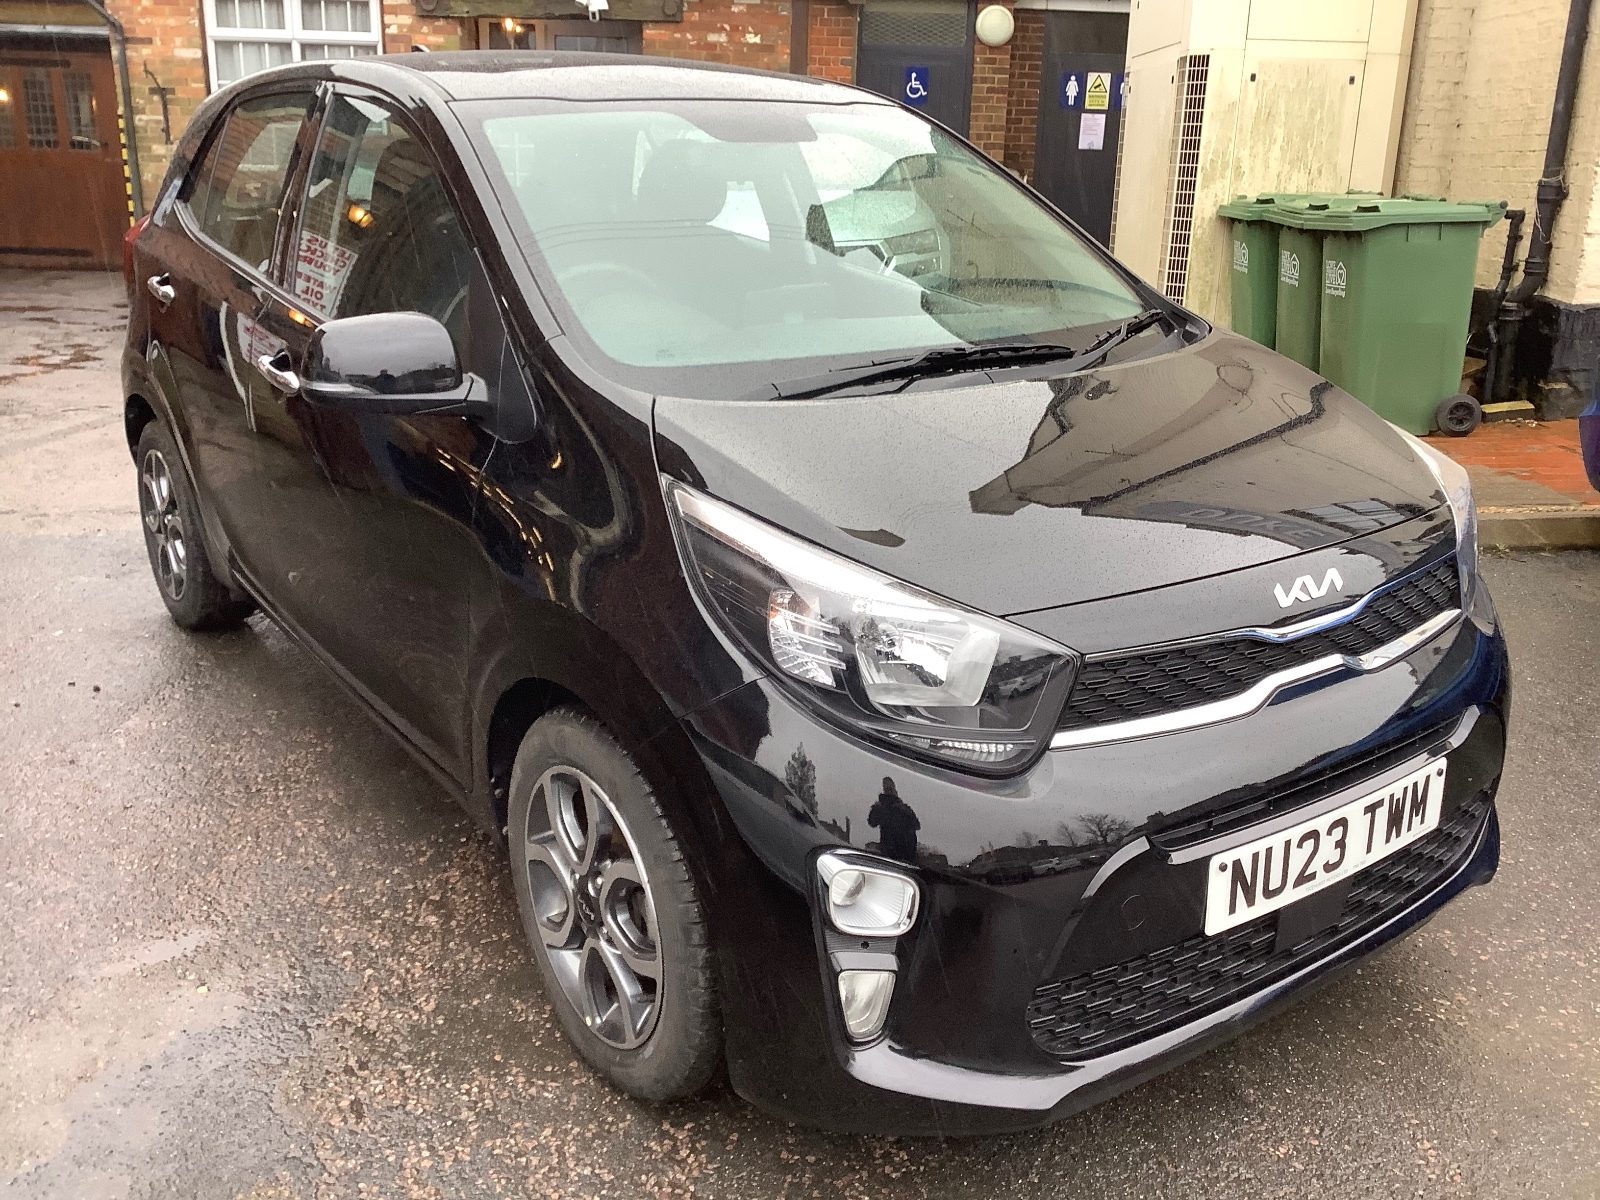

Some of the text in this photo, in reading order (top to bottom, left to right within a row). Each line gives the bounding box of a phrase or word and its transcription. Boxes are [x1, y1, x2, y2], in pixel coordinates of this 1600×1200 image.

[1274, 567, 1344, 608] KIA
[1228, 774, 1432, 916] NU23 TWM
